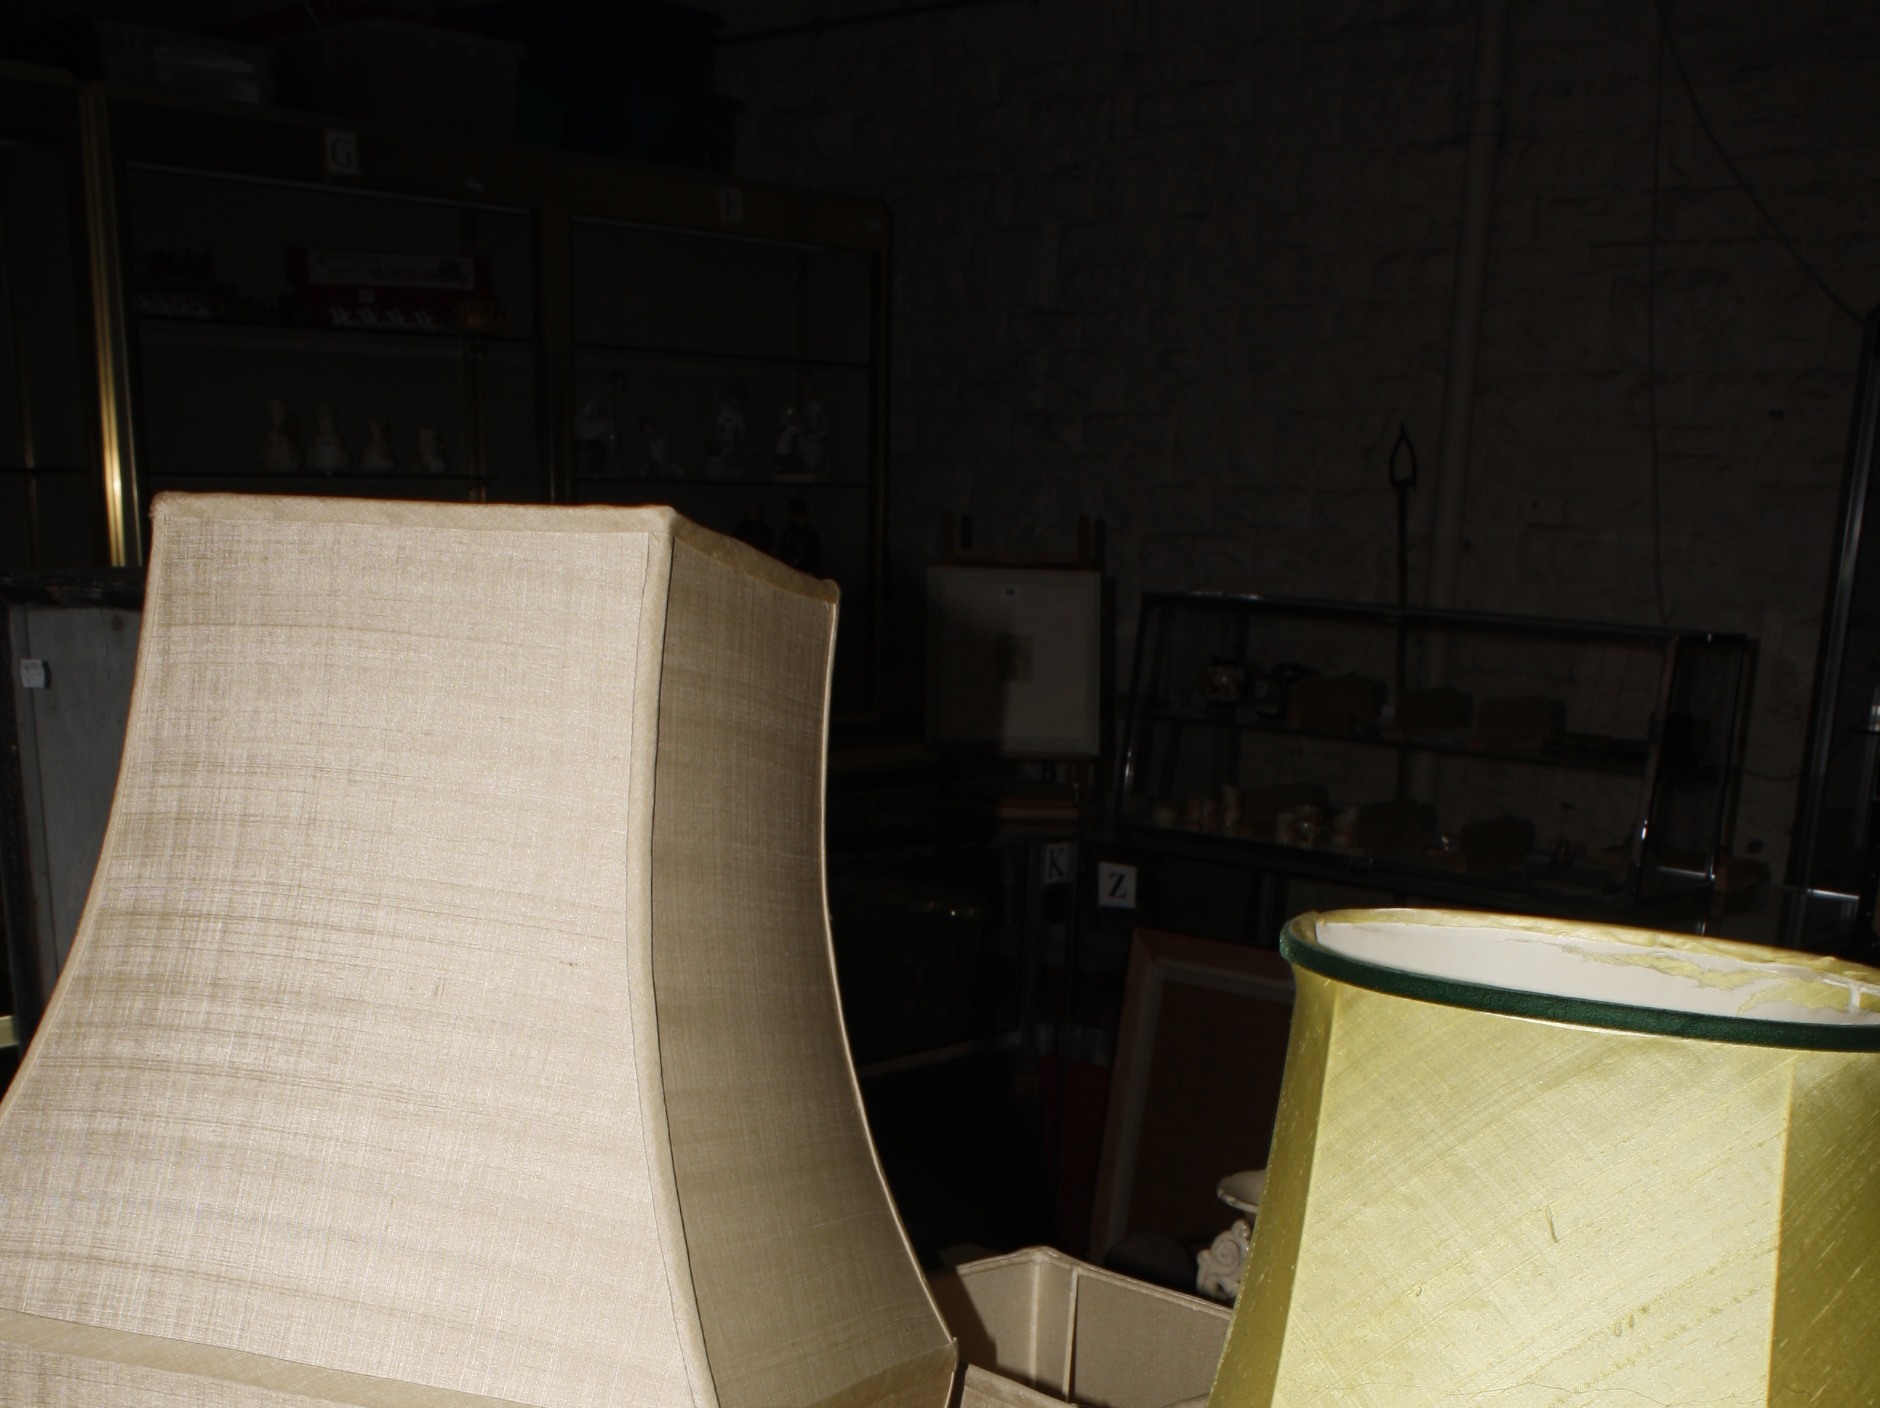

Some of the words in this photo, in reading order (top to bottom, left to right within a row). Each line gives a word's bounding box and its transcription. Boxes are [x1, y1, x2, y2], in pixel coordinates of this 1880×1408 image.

[331, 137, 352, 168] G
[1047, 847, 1066, 878] K
[1108, 871, 1127, 899] Z
